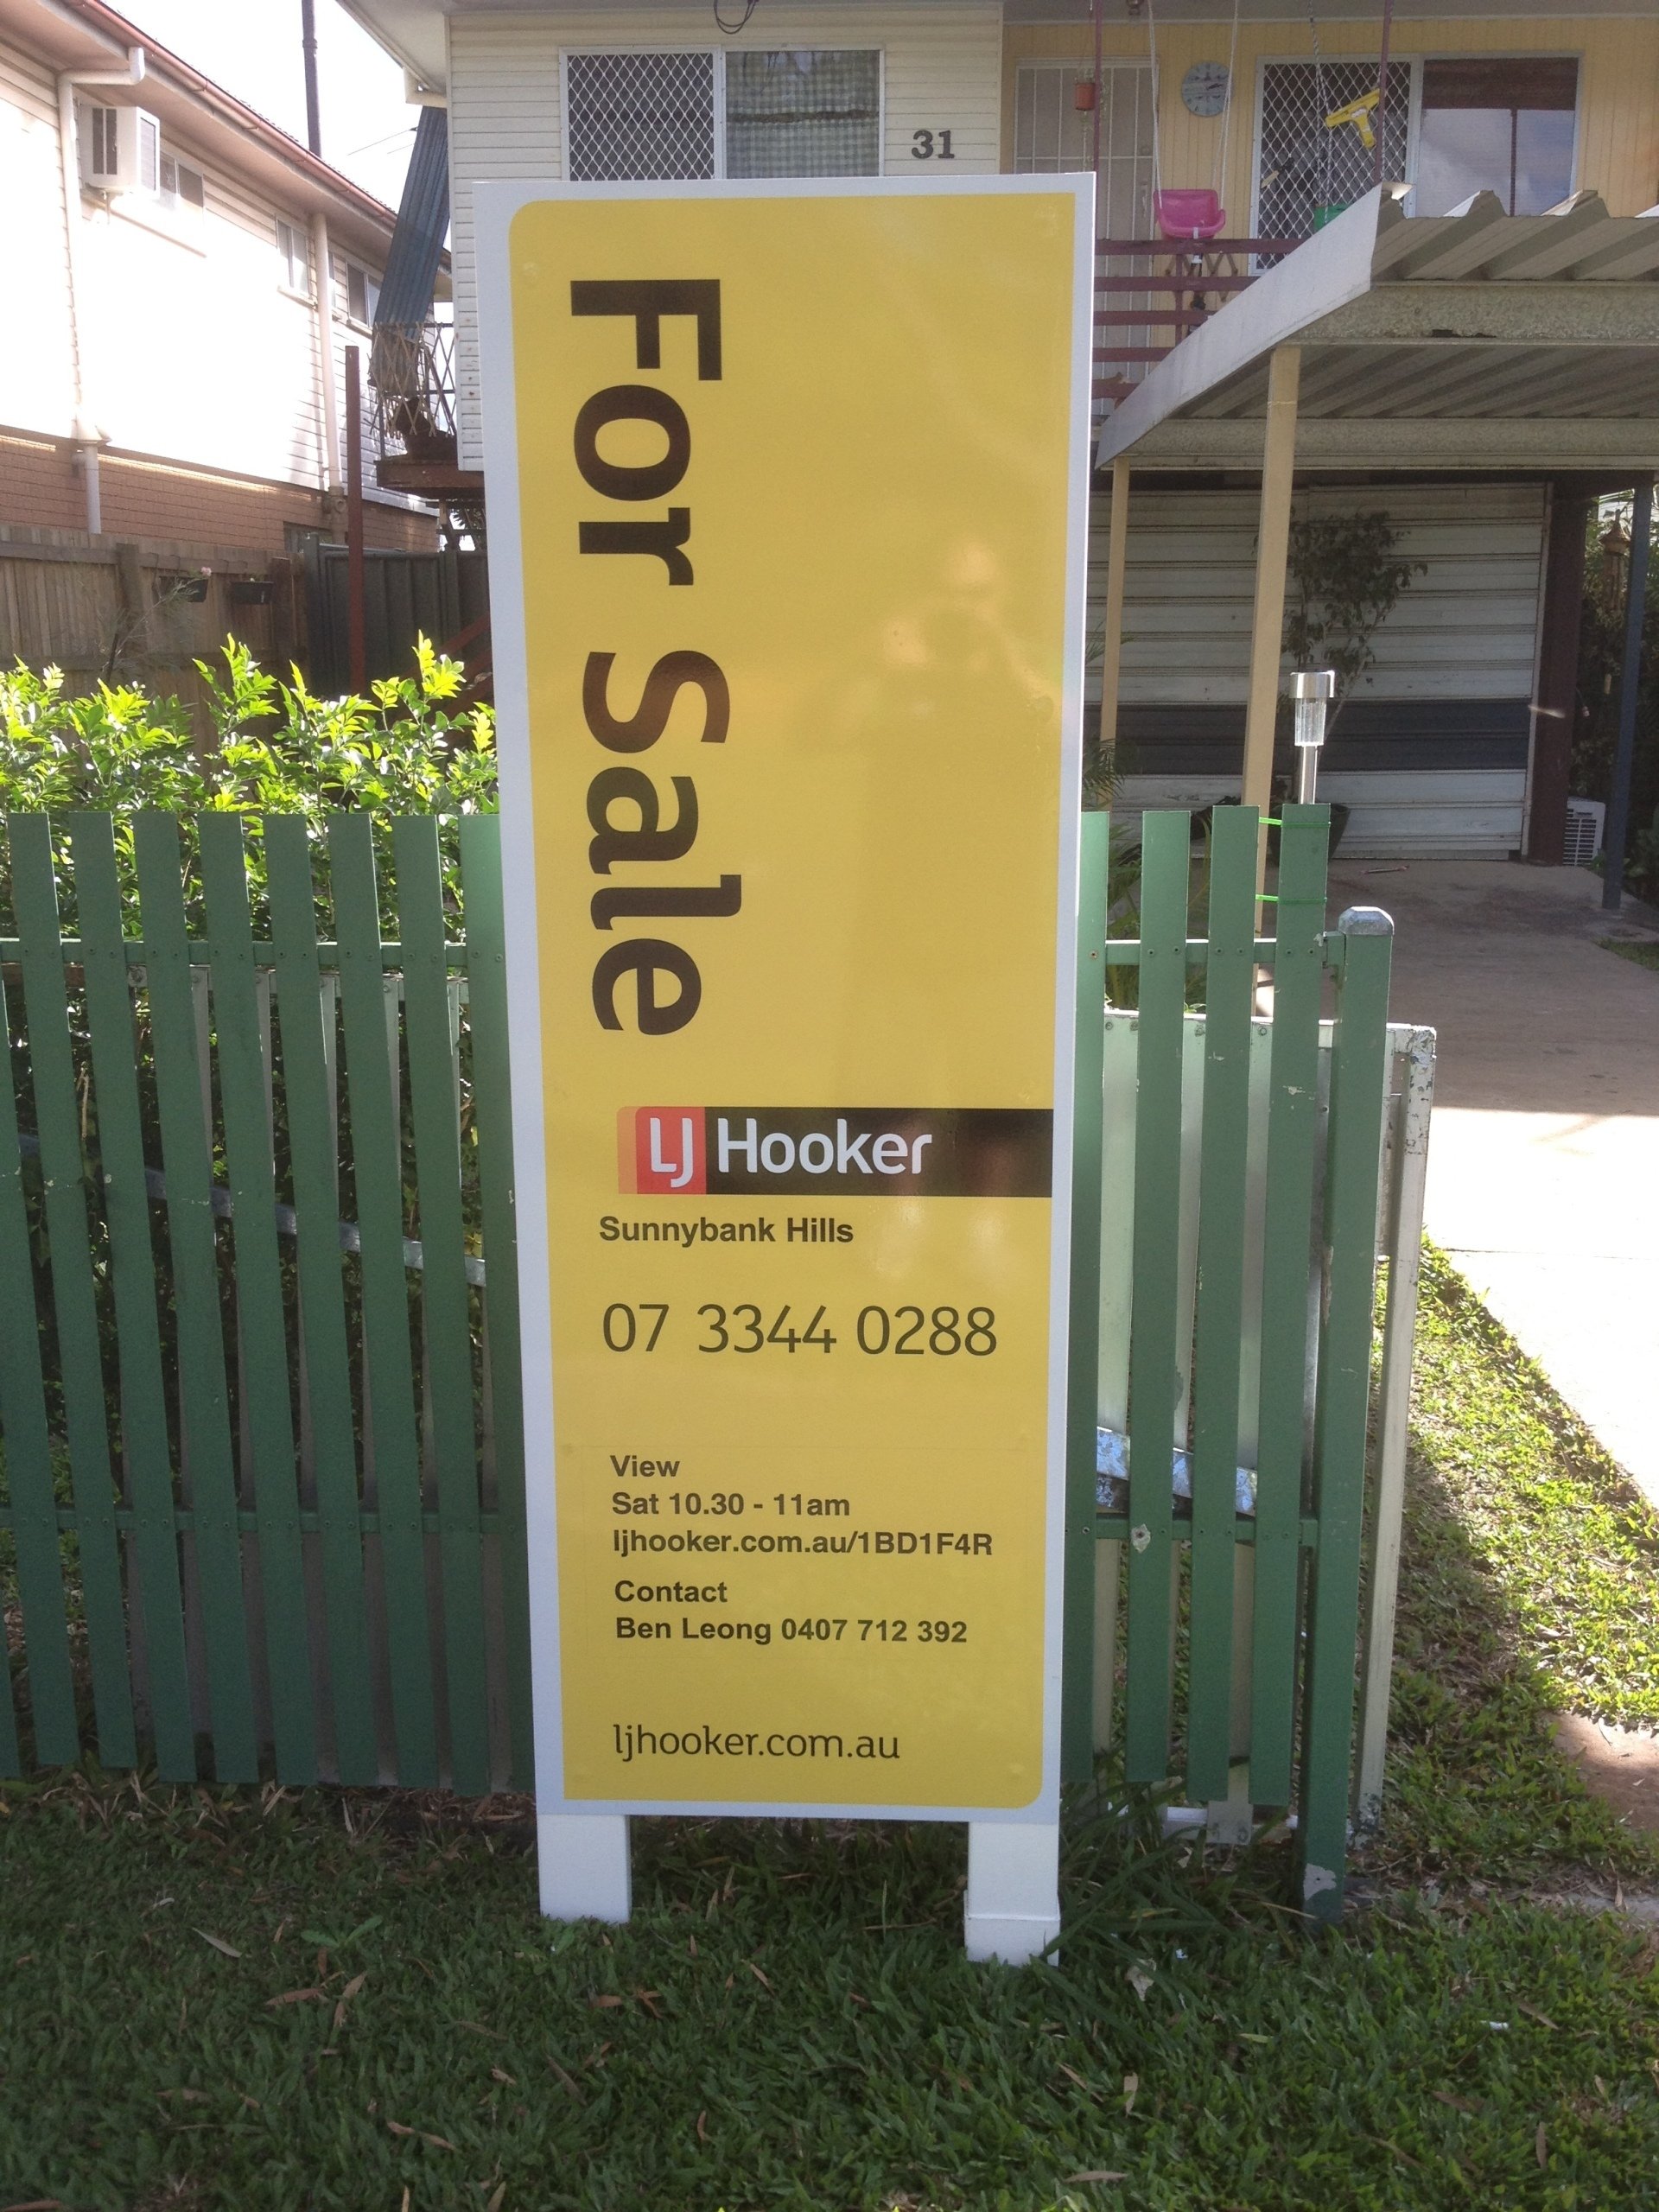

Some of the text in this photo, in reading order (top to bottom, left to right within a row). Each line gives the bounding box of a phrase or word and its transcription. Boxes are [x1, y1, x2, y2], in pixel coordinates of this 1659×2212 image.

[911, 130, 956, 159] 31
[569, 278, 742, 1036] For Sale
[650, 1117, 932, 1188] LJ Hooker
[599, 1216, 854, 1248] Sunnybank Hills
[602, 1303, 997, 1357] 07 3344 0288
[610, 1455, 681, 1478] View
[612, 1491, 659, 1515] Sat
[669, 1492, 745, 1516] 10.30
[773, 1493, 850, 1516] 11am
[613, 1529, 993, 1557] ljhooker.com.au/1BD1F4R
[614, 1580, 728, 1603] Contact
[616, 1617, 967, 1645] Ben Leong 0407 712 392
[613, 1724, 900, 1763] ljhooker.com.au
